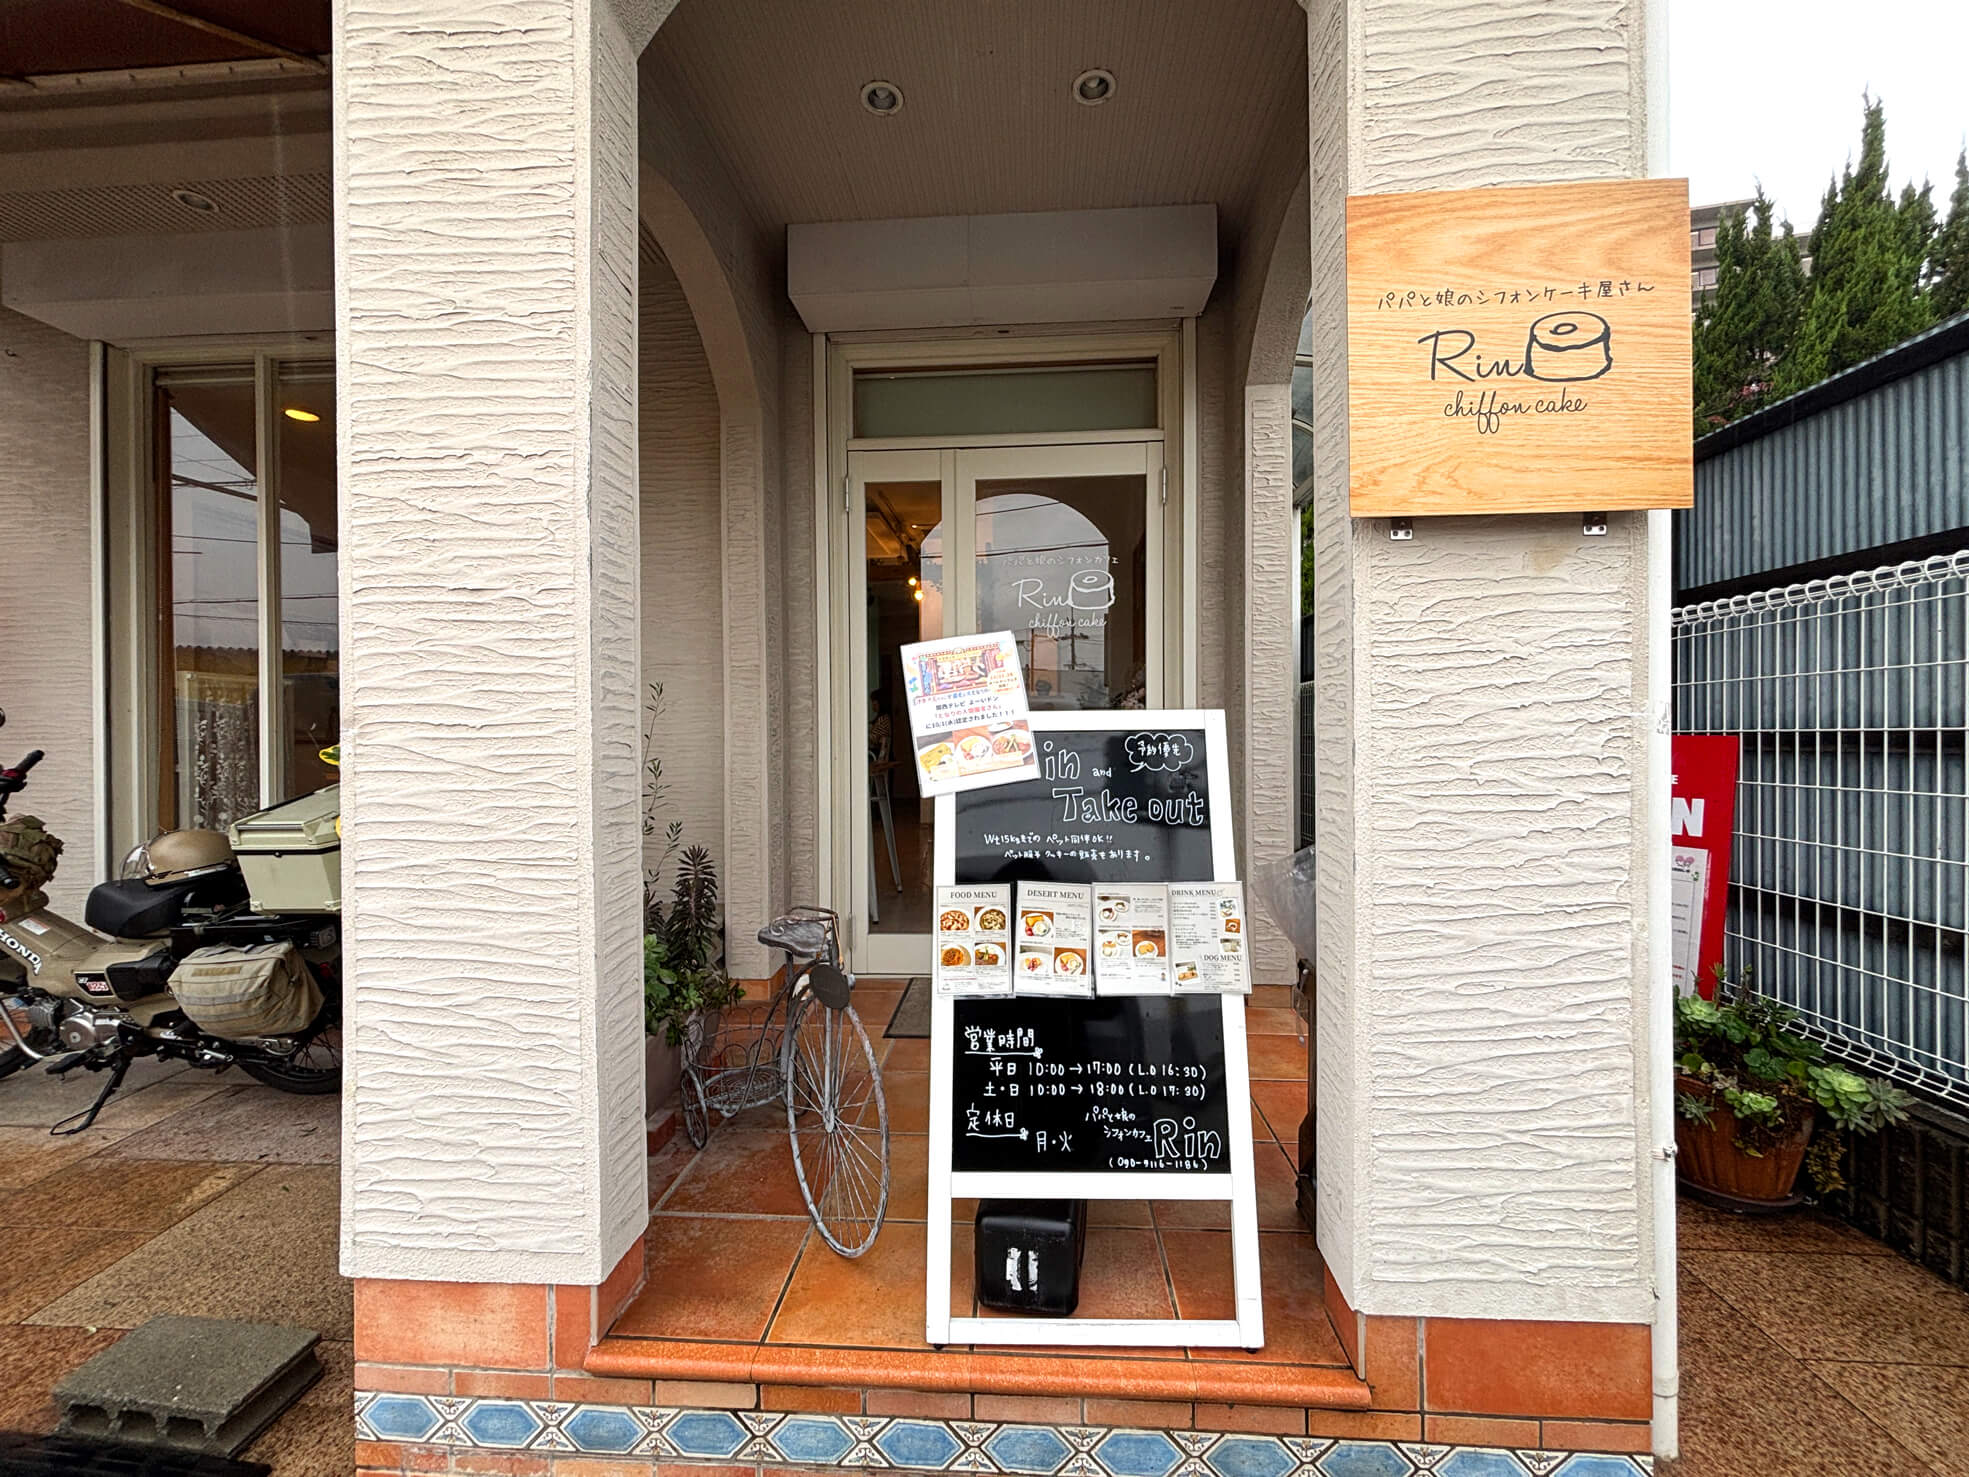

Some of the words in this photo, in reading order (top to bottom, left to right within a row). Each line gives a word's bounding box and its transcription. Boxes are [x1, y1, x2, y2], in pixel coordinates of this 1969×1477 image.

[1377, 279, 1655, 310] パパと娘のシフォンケーキ屋さん
[1417, 329, 1524, 382] Rin
[1444, 390, 1530, 434] chiffon
[1535, 387, 1588, 413] cake
[1011, 578, 1071, 608] Rin
[1078, 612, 1107, 627] cake
[1043, 741, 1081, 780] in
[1092, 767, 1113, 778] and
[1052, 787, 1138, 823] Take
[1148, 791, 1204, 826] out
[950, 891, 972, 899] FOOD
[974, 890, 998, 899] MENU
[1059, 892, 1085, 900] MENU
[1171, 889, 1194, 897] DRINK
[1195, 889, 1217, 897] MENU
[1203, 954, 1219, 962] DOG
[1221, 954, 1242, 962] MENU
[964, 1025, 1035, 1053] 営業時間
[990, 1057, 1017, 1077] 平日
[1029, 1061, 1065, 1077] 10:00
[1087, 1060, 1121, 1076] 17:00
[1030, 1083, 1065, 1097] 10:00
[1090, 1081, 1124, 1097] 18:00
[966, 1102, 1014, 1131] 定休日
[1103, 1124, 1153, 1142] シフォンカフェ
[1153, 1116, 1221, 1159] Rin
